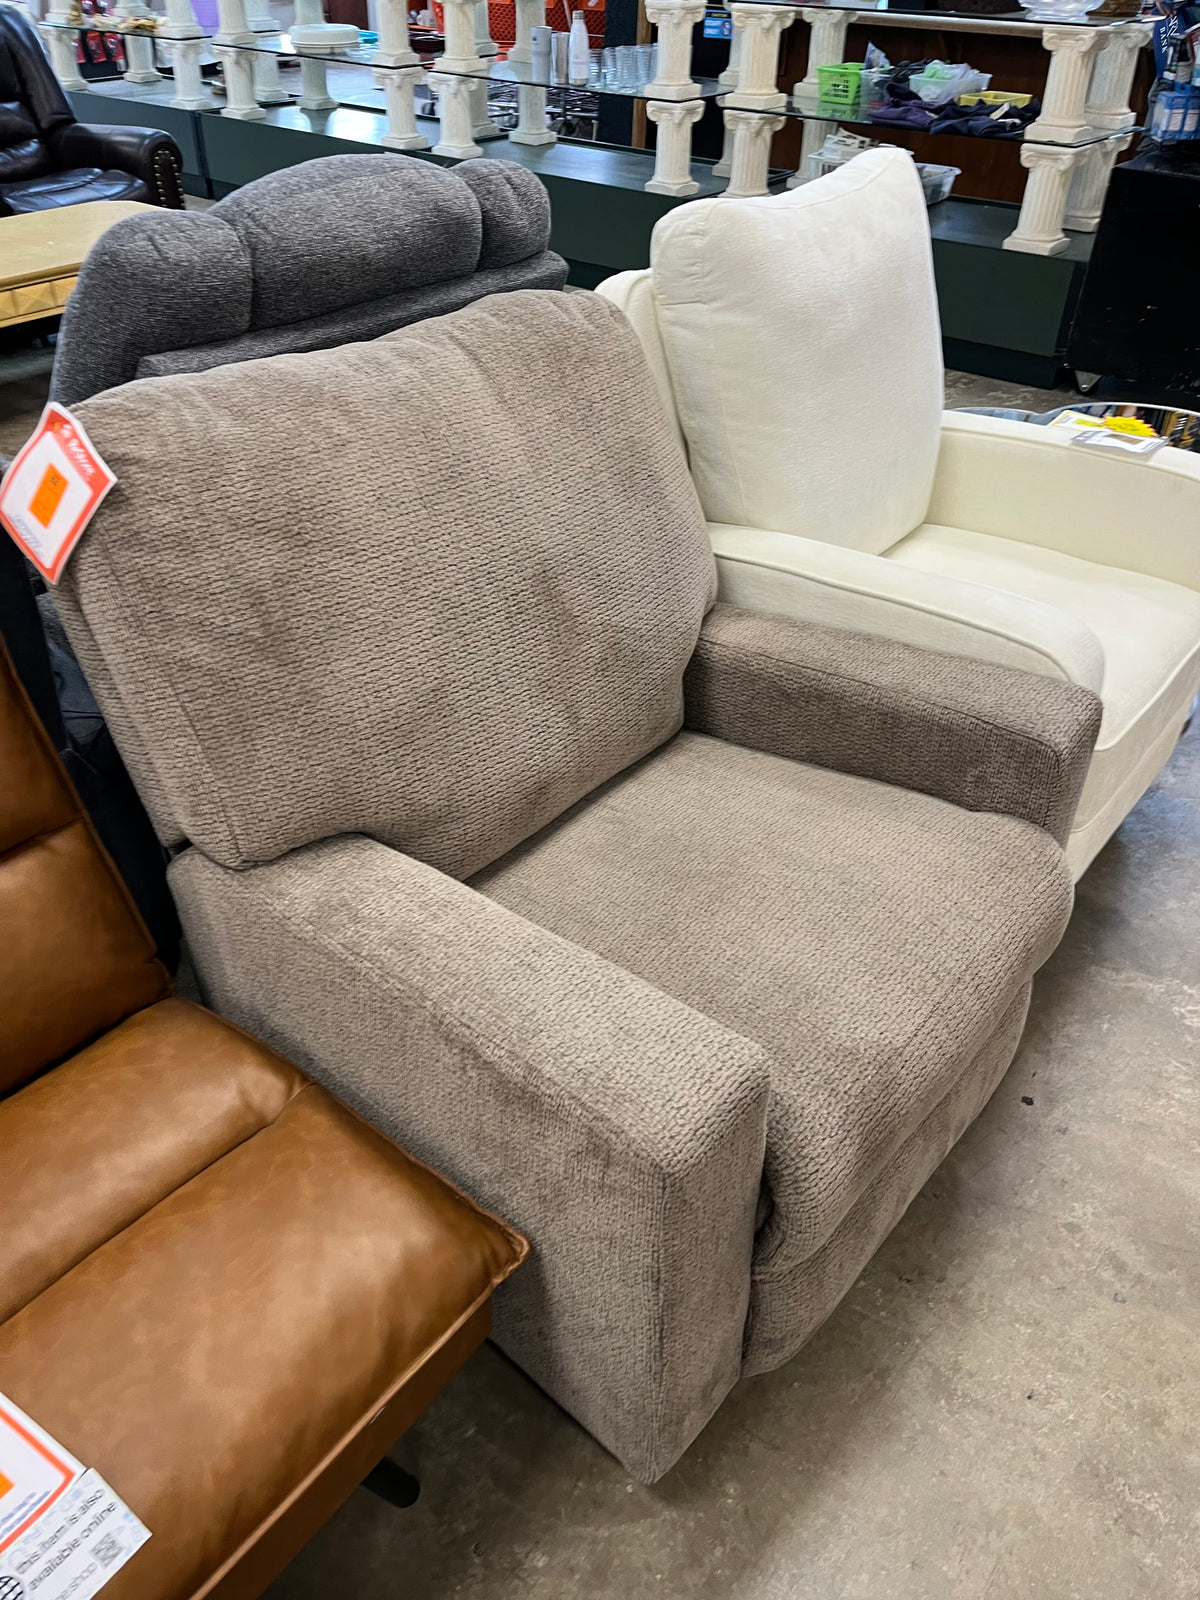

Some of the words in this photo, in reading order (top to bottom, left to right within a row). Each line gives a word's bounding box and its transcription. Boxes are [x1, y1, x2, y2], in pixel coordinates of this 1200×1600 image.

[28, 1537, 81, 1591] available
[80, 1501, 117, 1539] online
[40, 1524, 68, 1552] item
[66, 1513, 79, 1526] is
[78, 1489, 105, 1516] also
